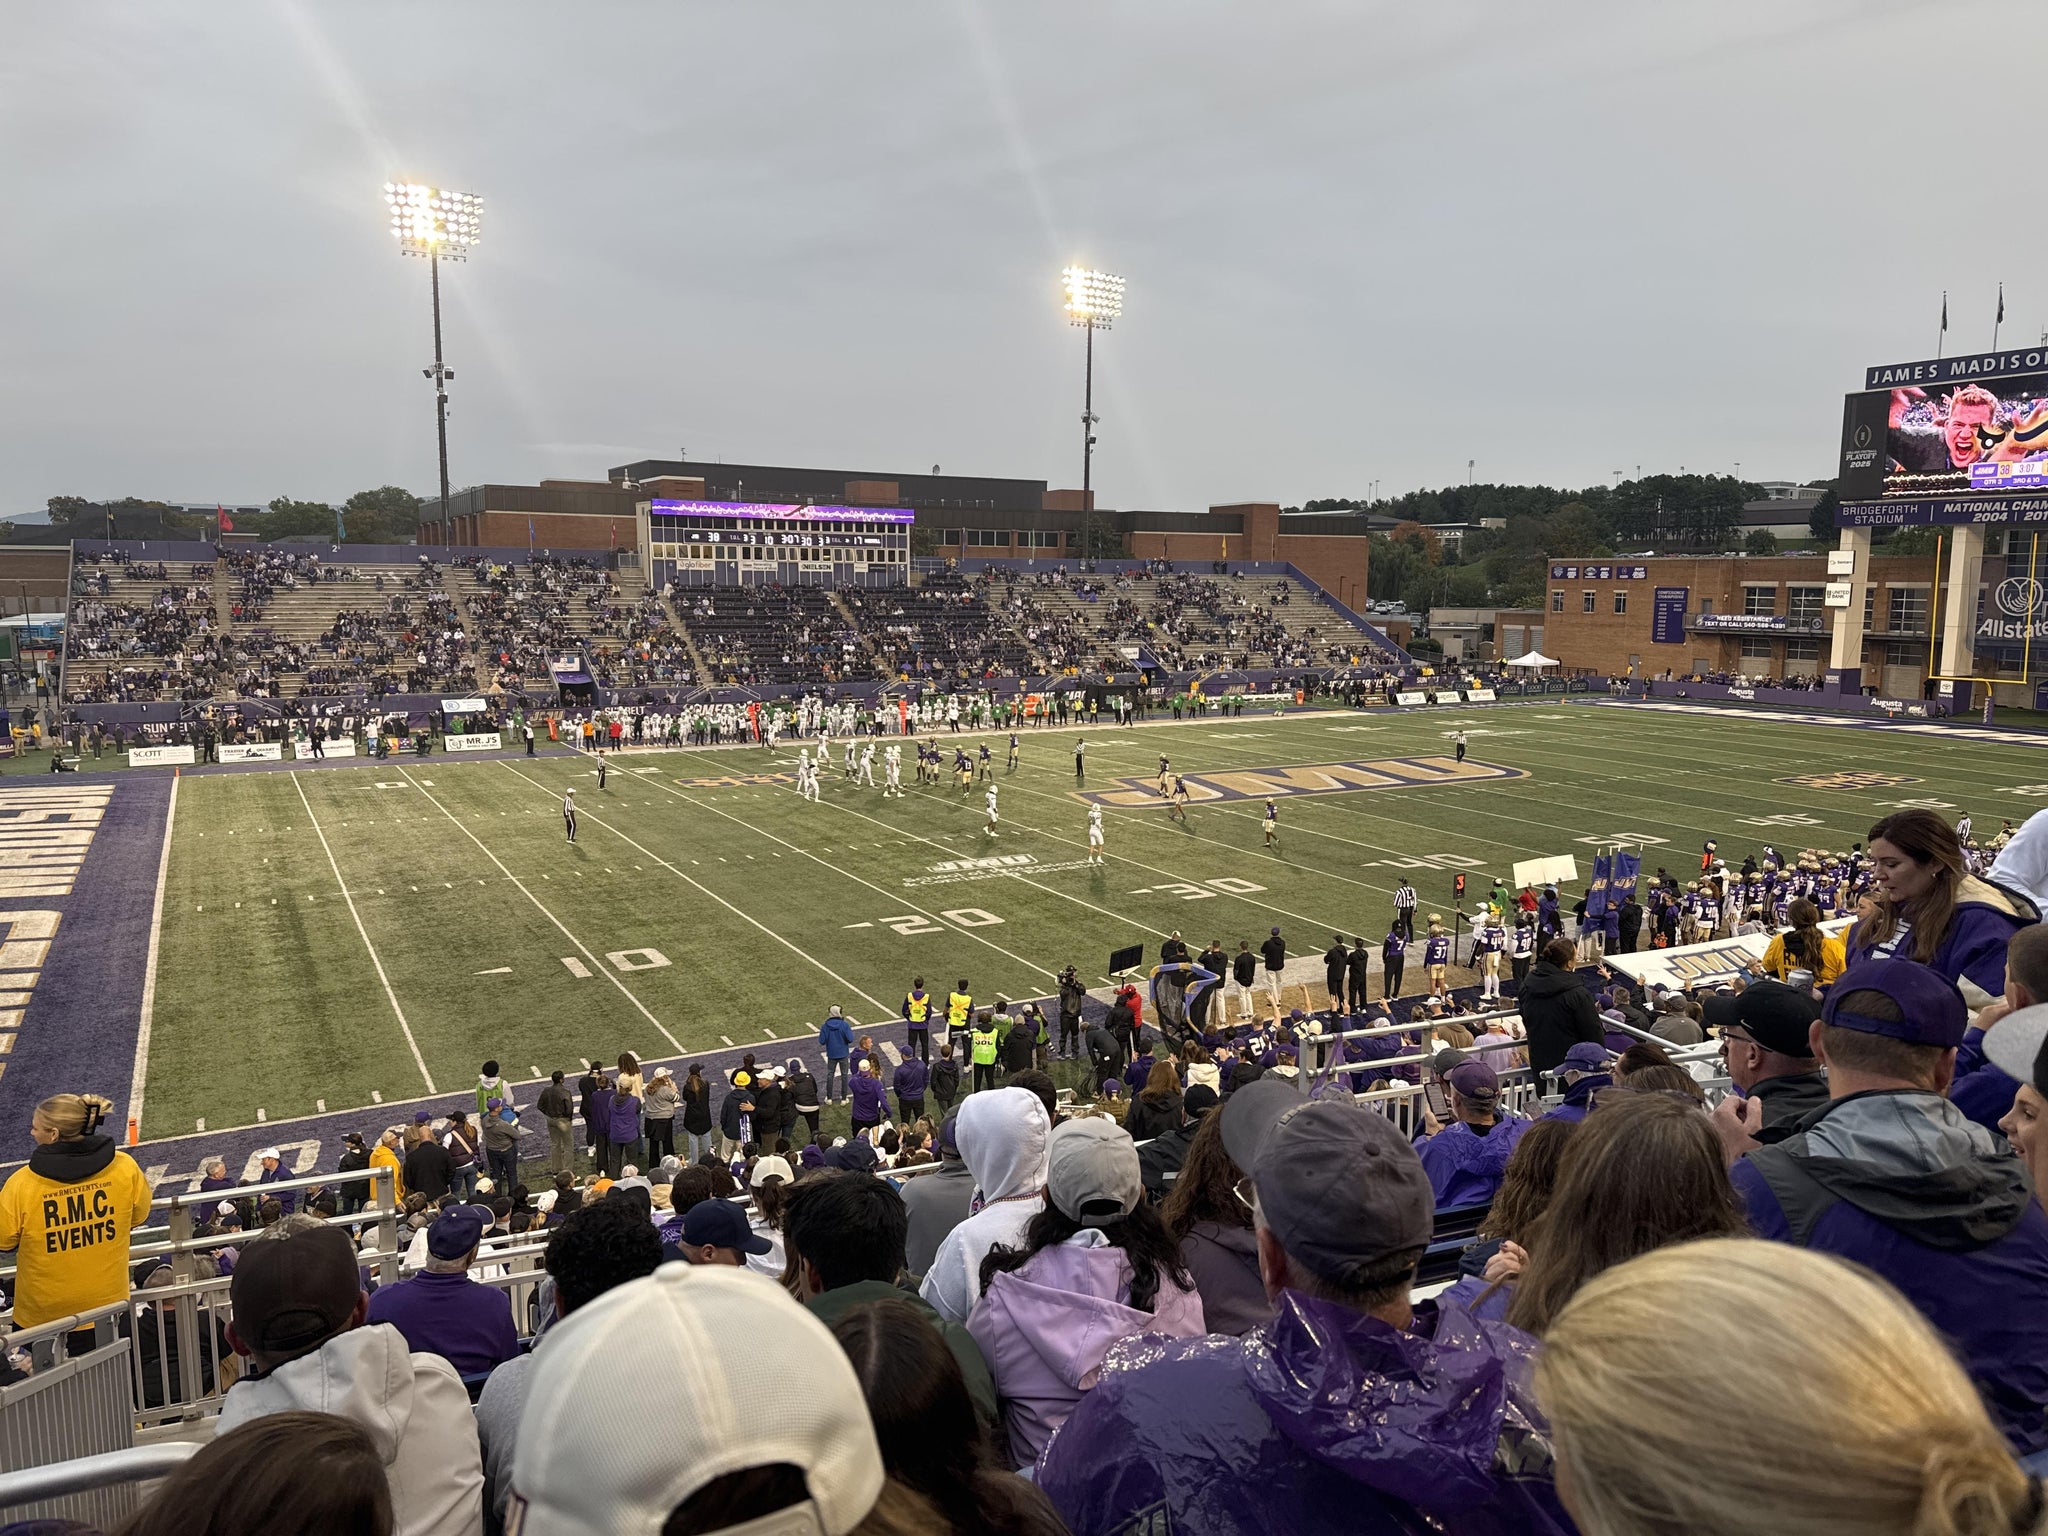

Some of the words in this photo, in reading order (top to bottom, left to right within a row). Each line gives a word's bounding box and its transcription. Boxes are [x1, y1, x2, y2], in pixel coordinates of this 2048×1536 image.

[1872, 365, 1938, 384] JAMES
[1951, 352, 2048, 375] MADISO
[1846, 453, 1877, 461] PLAYOFF
[1850, 460, 1871, 468] 2025
[2000, 464, 2010, 475] 38
[2019, 463, 2035, 473] 3:07
[1842, 504, 1918, 516] BRIDGEFORTH
[1944, 501, 2008, 513] NATIONAL
[1854, 514, 1904, 524] STADIUM
[1972, 511, 2008, 522] 2004
[141, 541, 146, 550] 1
[707, 532, 720, 542] 38
[743, 534, 748, 542] 3
[750, 535, 756, 545] 3
[764, 536, 774, 545] 10
[801, 536, 812, 546] 30
[818, 536, 824, 547] 3
[825, 536, 831, 544] 3
[853, 536, 863, 545] 17
[332, 544, 337, 553] 2
[1976, 618, 2048, 639] Allstate
[1150, 687, 1166, 695] BELT
[1727, 686, 1755, 697] Augusta
[1870, 697, 1903, 709] Augusta
[143, 723, 168, 733] SUN
[466, 737, 484, 745] MR.
[485, 736, 497, 744] J'S
[133, 750, 163, 758] SCOTT
[965, 762, 972, 770] 13
[1064, 754, 1533, 810] JMU
[1572, 832, 1671, 849] 50
[926, 853, 1039, 874] JMU
[1380, 853, 1489, 871] 40
[1456, 874, 1464, 889] 3
[1151, 877, 1269, 900] 30
[878, 907, 1007, 936] 20
[1397, 940, 1404, 950] 7
[1434, 946, 1447, 959] 37
[559, 948, 673, 979] 10
[1664, 945, 1756, 981] JMU
[975, 1035, 994, 1046] SBC
[42, 1180, 113, 1200] www.RMCEVENTS.com
[43, 1189, 115, 1228] R.M.C.
[46, 1219, 116, 1254] EVENTS
